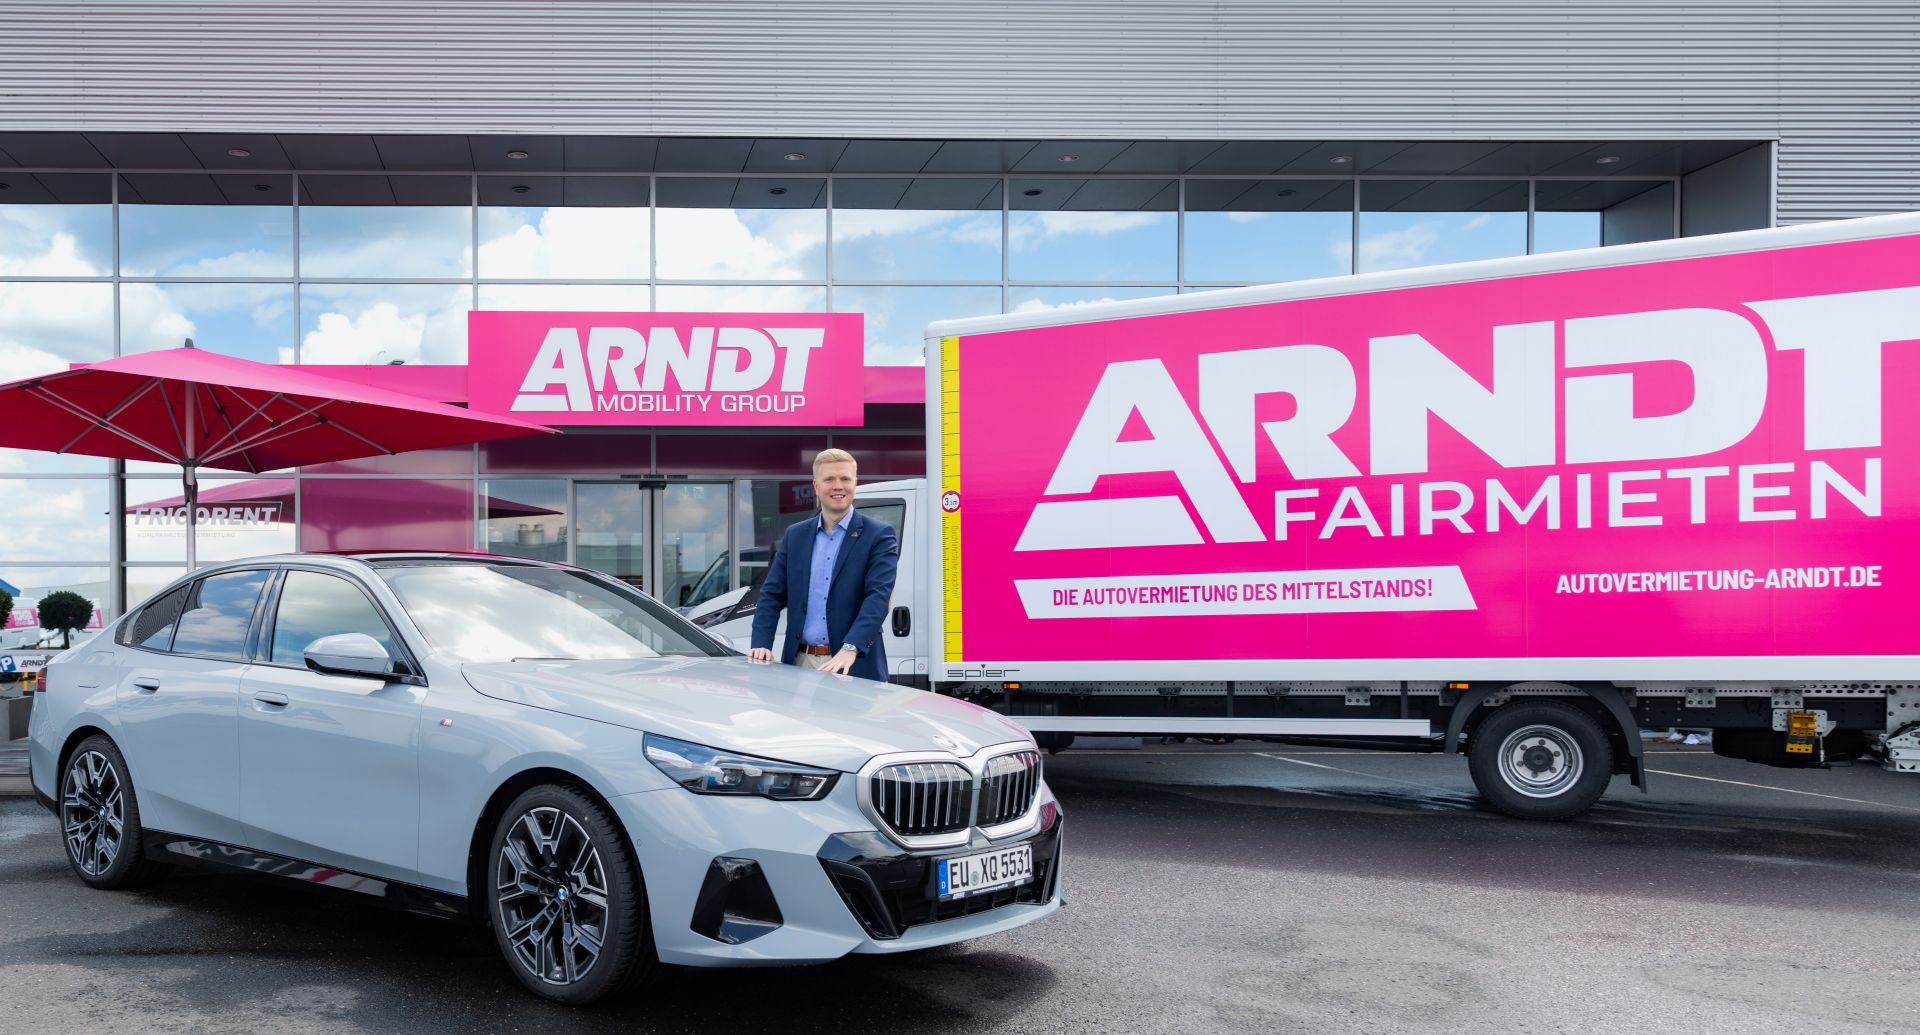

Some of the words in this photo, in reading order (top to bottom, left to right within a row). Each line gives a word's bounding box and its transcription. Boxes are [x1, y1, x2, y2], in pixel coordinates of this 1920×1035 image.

[510, 327, 825, 411] ARNDT
[597, 394, 712, 412] MOBILITY
[720, 394, 806, 413] GROUP
[1014, 285, 1920, 551] ARNDT
[1274, 457, 1882, 541] FAIRMIETEN
[1053, 589, 1079, 606] DIE
[1082, 584, 1239, 605] AUTOVERMIETUNG
[1242, 582, 1278, 601] DES
[1281, 578, 1434, 601] MITTELSTANDS!
[1555, 565, 1883, 594] AUTOVERMIETUNG-ARNDT.DE
[947, 664, 1021, 681] spier
[949, 861, 969, 889] EU
[981, 855, 998, 883] XQ
[1001, 848, 1031, 879] 5531
